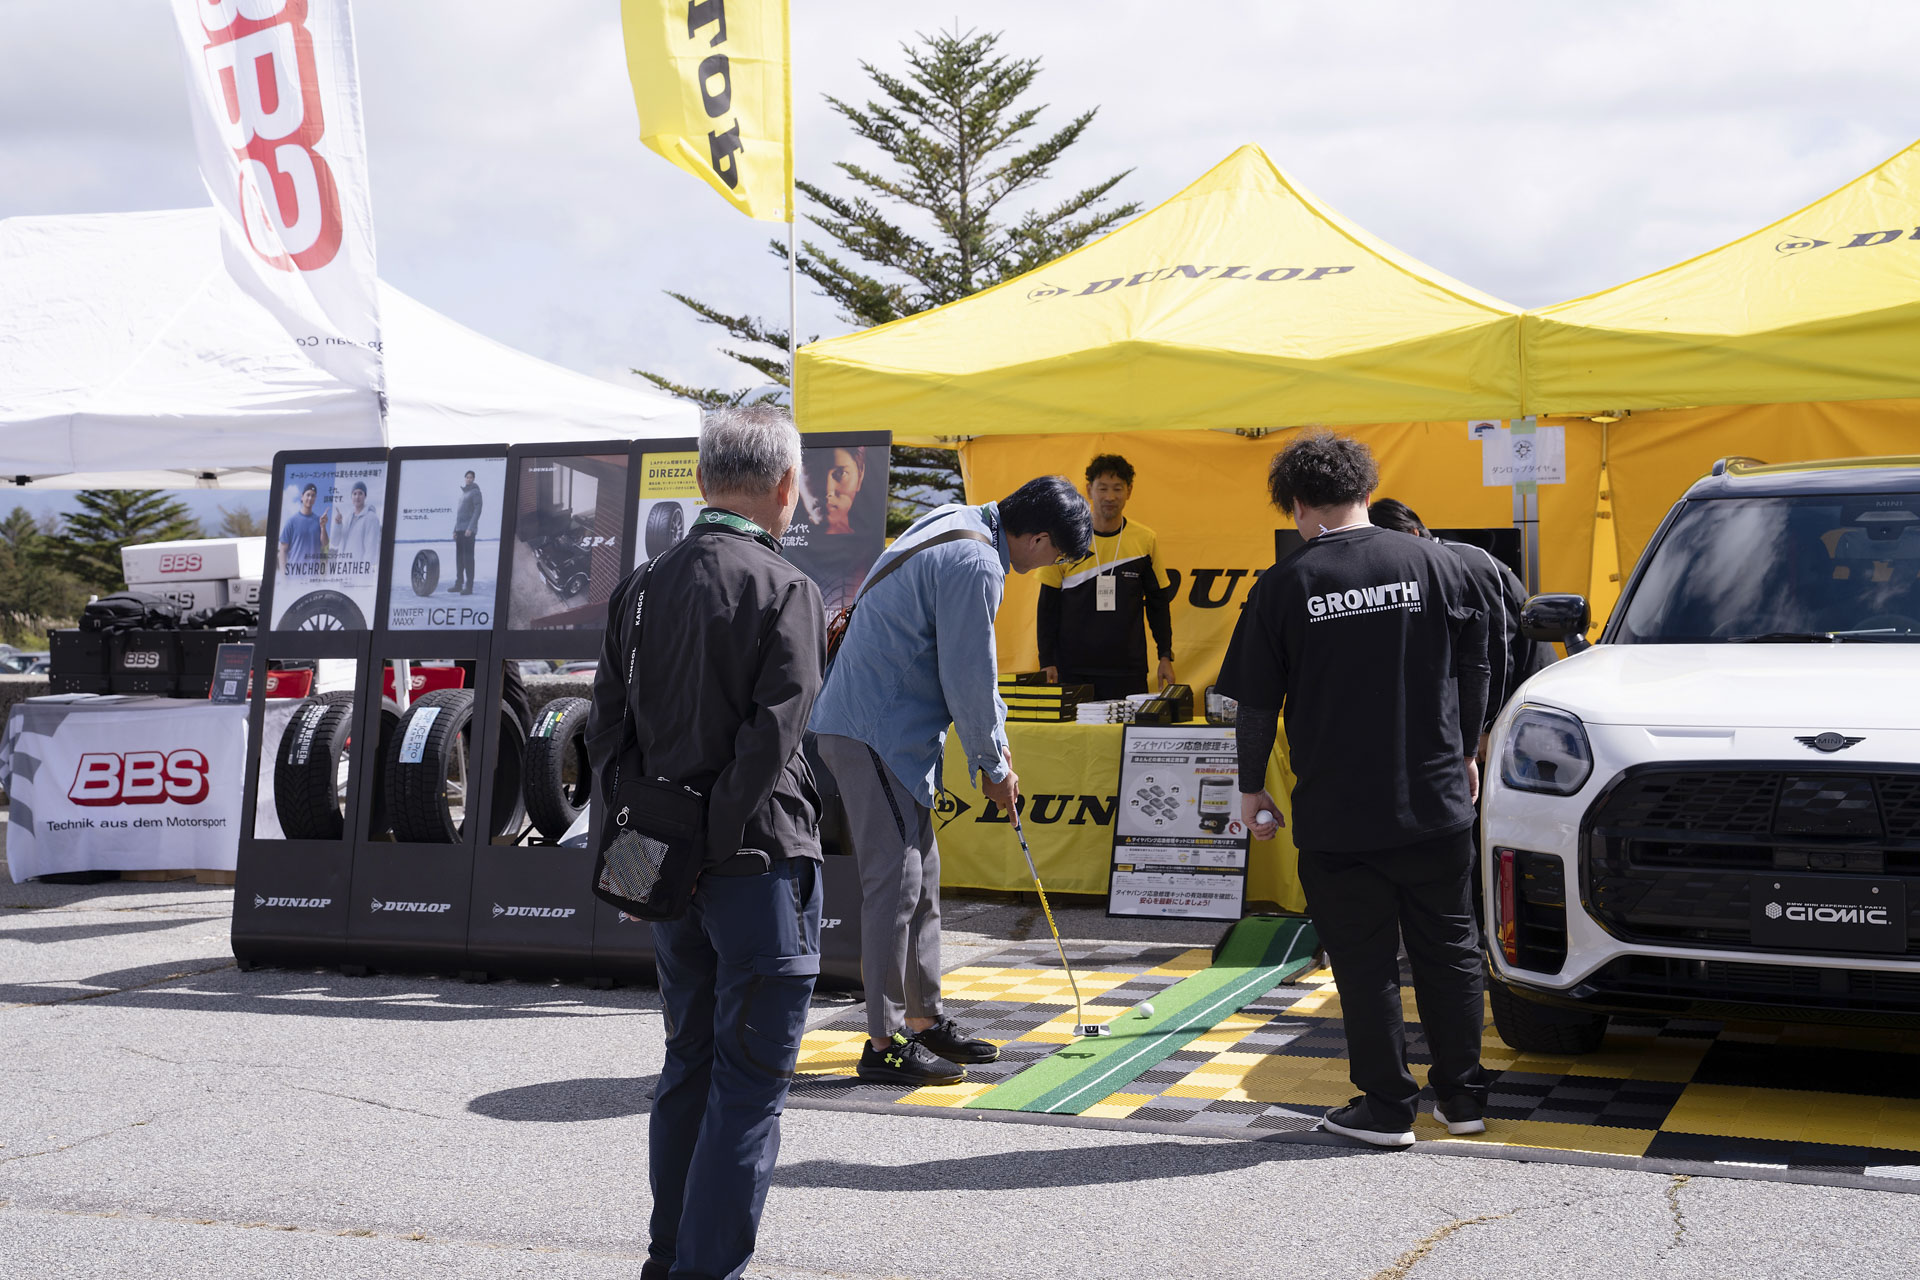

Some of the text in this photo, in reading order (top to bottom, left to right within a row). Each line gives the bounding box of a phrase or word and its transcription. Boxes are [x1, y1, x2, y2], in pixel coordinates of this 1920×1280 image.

[1072, 264, 1355, 297] DUNLOP
[649, 468, 693, 478] DIREZZA
[159, 554, 202, 573] BBS
[284, 561, 371, 576] SYNCHRO WEATHER
[1307, 581, 1420, 616] GROWTH
[393, 608, 424, 616] WINTER
[635, 590, 645, 626] KANGOL
[392, 618, 415, 626] MAXX
[427, 608, 489, 625] ICE Pro
[124, 652, 160, 668] BBS
[299, 730, 314, 759] WEATHER
[411, 743, 422, 759] Pro
[67, 749, 209, 806] BBS
[47, 817, 226, 831] Technik aus dem Motorsport
[265, 897, 332, 908] DUNLOP
[383, 902, 451, 913] DUNLOP
[504, 906, 576, 918] DUNLOP
[1785, 906, 1887, 925] GIOMIC
